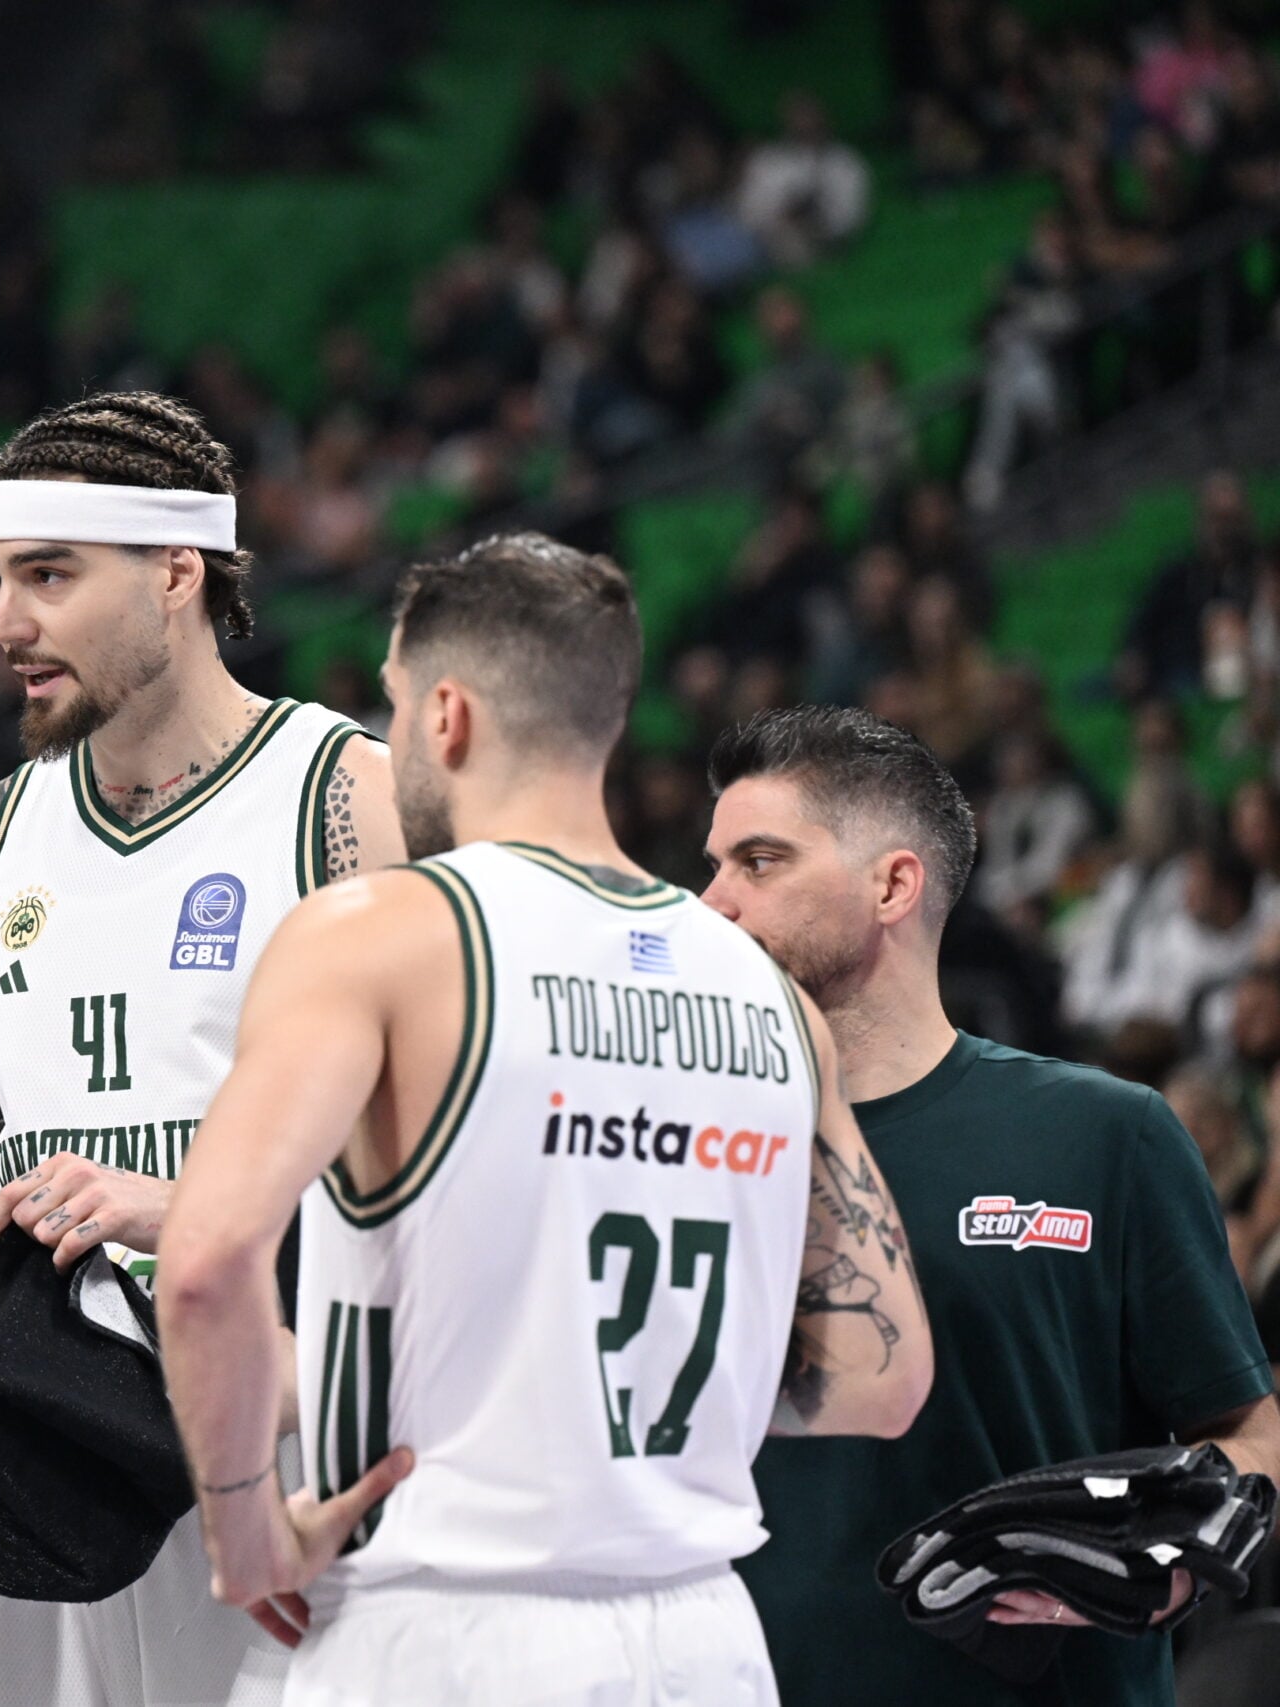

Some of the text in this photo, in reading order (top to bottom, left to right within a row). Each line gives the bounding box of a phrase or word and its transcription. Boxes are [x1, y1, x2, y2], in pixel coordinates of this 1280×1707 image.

[175, 944, 230, 967] GBL
[176, 931, 236, 944] Stoiximan
[70, 992, 132, 1093] 41
[532, 975, 790, 1085] TOLIOPOULOS
[543, 1091, 789, 1177] instacar
[587, 1211, 731, 1459] 27
